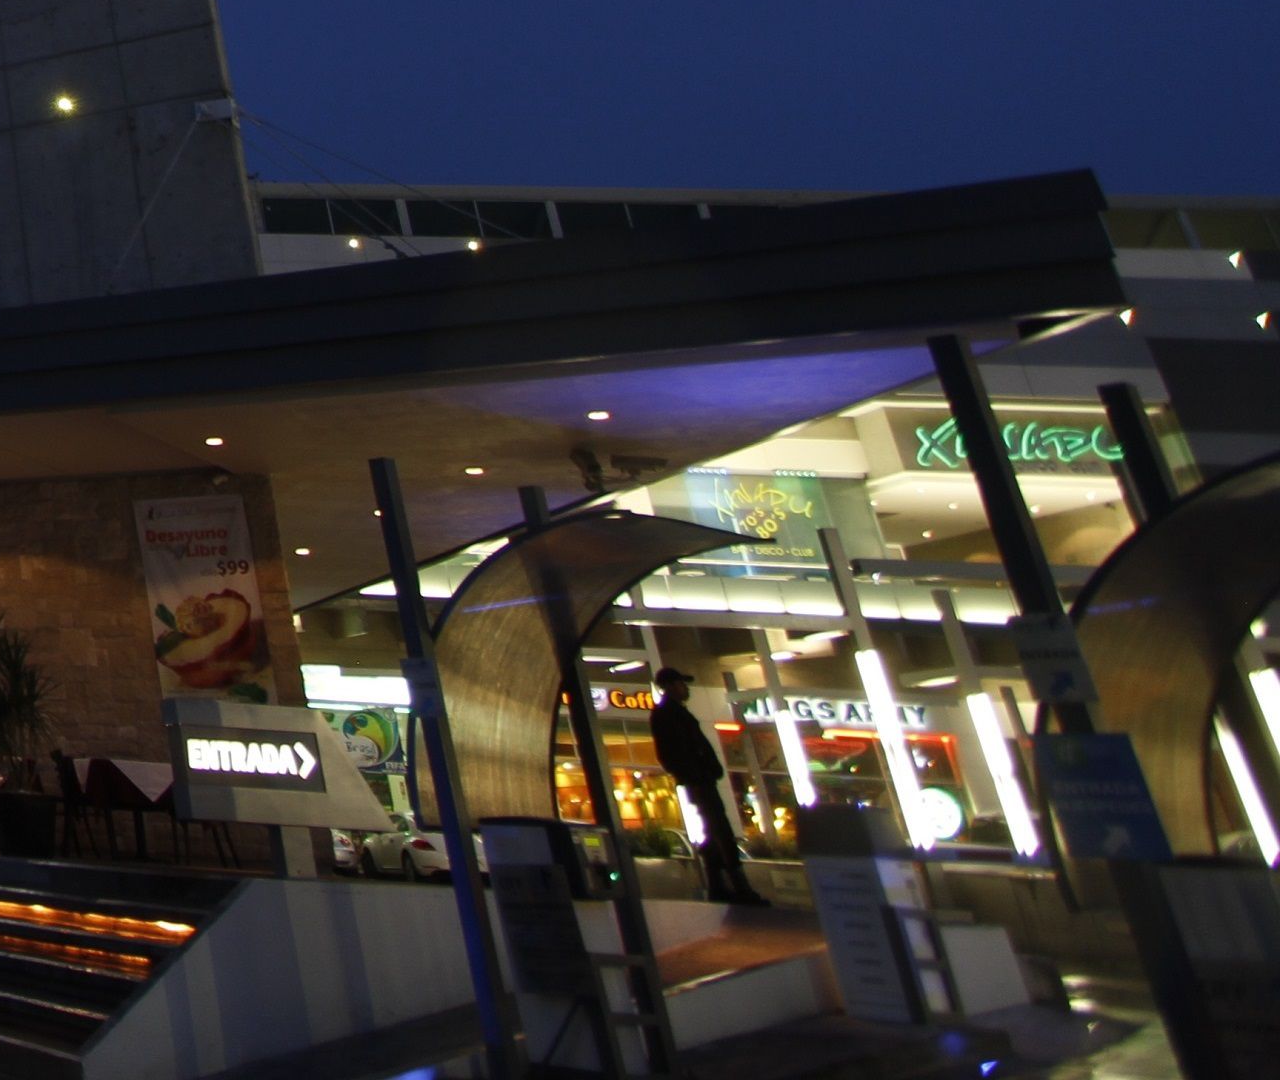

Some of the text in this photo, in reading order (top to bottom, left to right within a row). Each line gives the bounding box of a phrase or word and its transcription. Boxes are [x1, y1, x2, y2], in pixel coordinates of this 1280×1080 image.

[145, 528, 228, 544] Desayuno
[186, 544, 228, 558] Libre
[217, 559, 250, 577] $99
[186, 738, 299, 776] ENTRADA
